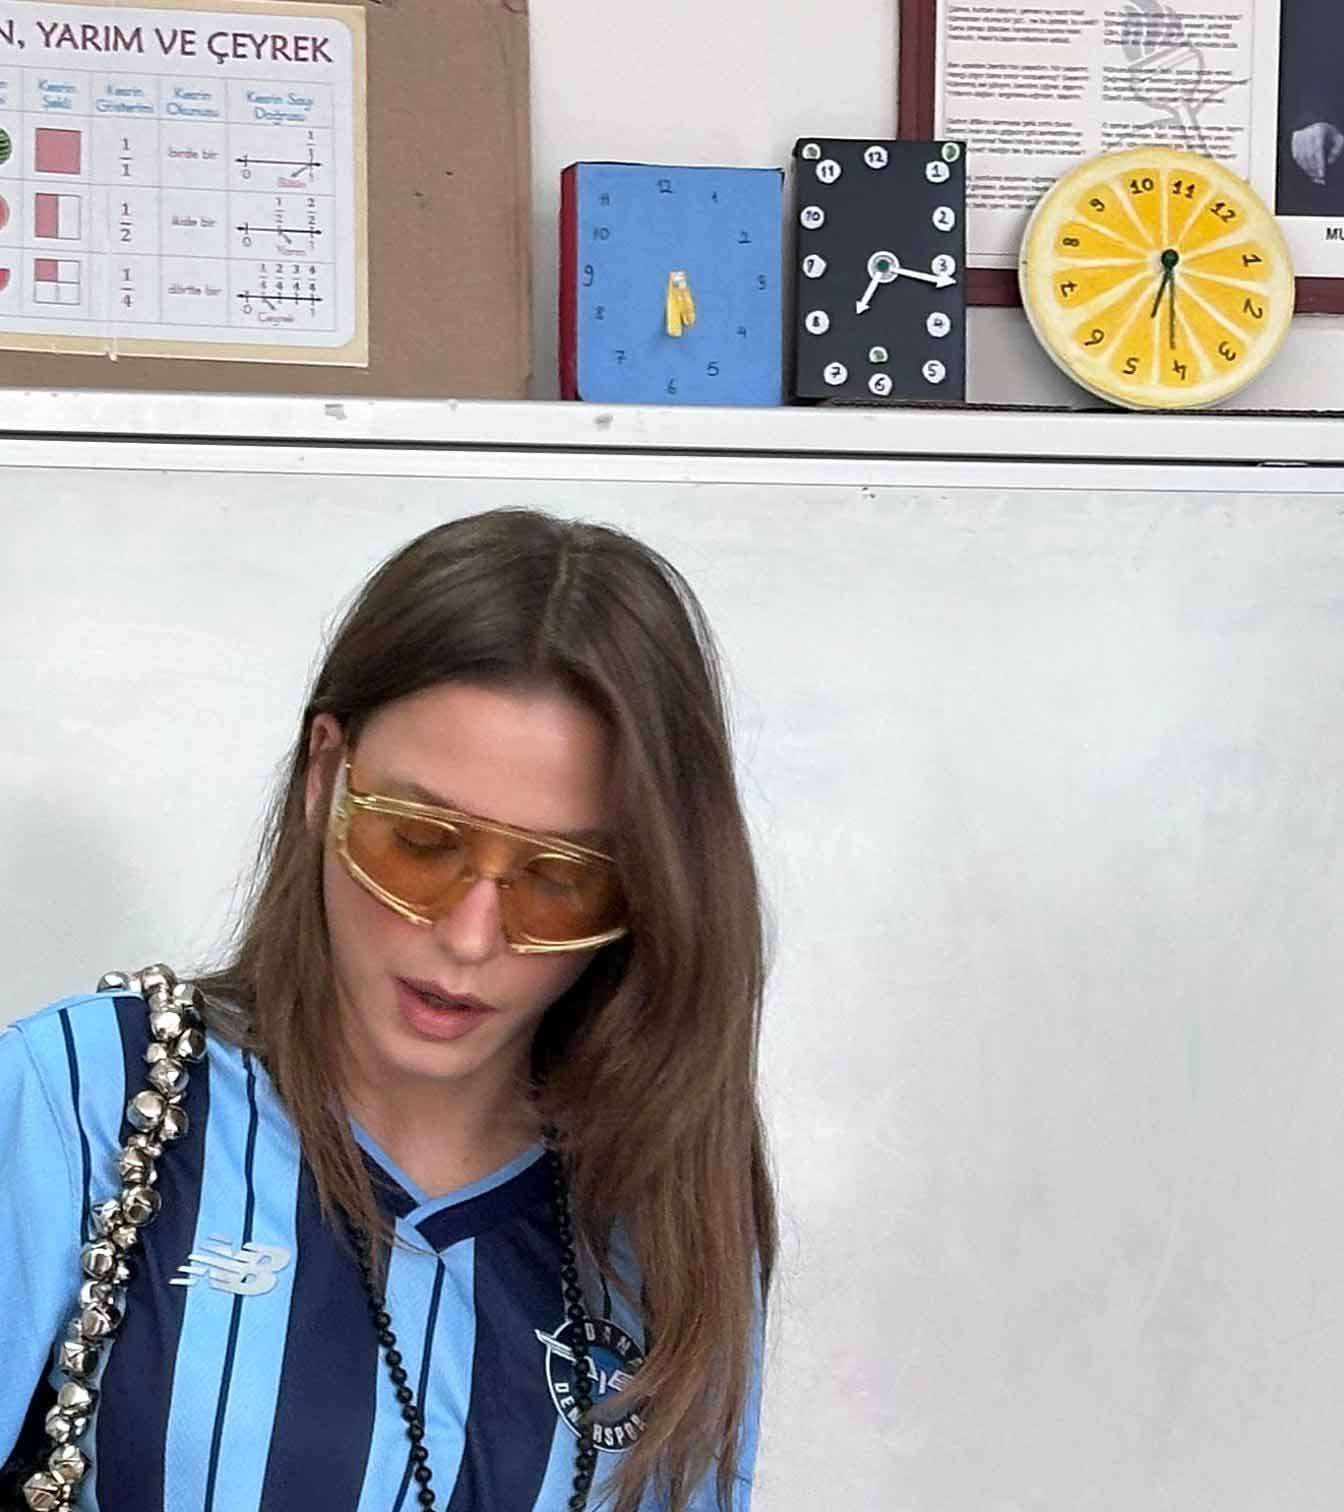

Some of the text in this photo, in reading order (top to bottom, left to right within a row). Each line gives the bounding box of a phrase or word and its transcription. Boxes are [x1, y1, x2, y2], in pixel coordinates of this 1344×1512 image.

[36, 21, 145, 53] YARIM
[155, 27, 197, 57] VE
[207, 31, 334, 65] ÇEYREK
[868, 151, 886, 164] 12
[820, 165, 835, 178] 11
[931, 165, 943, 178] 1
[1129, 177, 1155, 195] 10
[1171, 179, 1197, 199] 11
[805, 211, 821, 222] 10
[938, 211, 949, 225] 2
[1210, 201, 1237, 223] 12
[593, 227, 610, 241] 10
[1062, 236, 1080, 248] 8
[939, 258, 949, 272] 3
[583, 264, 595, 288] 9
[1243, 298, 1264, 320] 2
[1218, 341, 1237, 362] 3
[706, 361, 721, 377] 5
[830, 366, 842, 379] 7
[927, 363, 938, 378] 5
[1122, 356, 1140, 376] 5
[1172, 360, 1189, 381] 4
[667, 378, 678, 395] 6
[874, 378, 886, 392] 6
